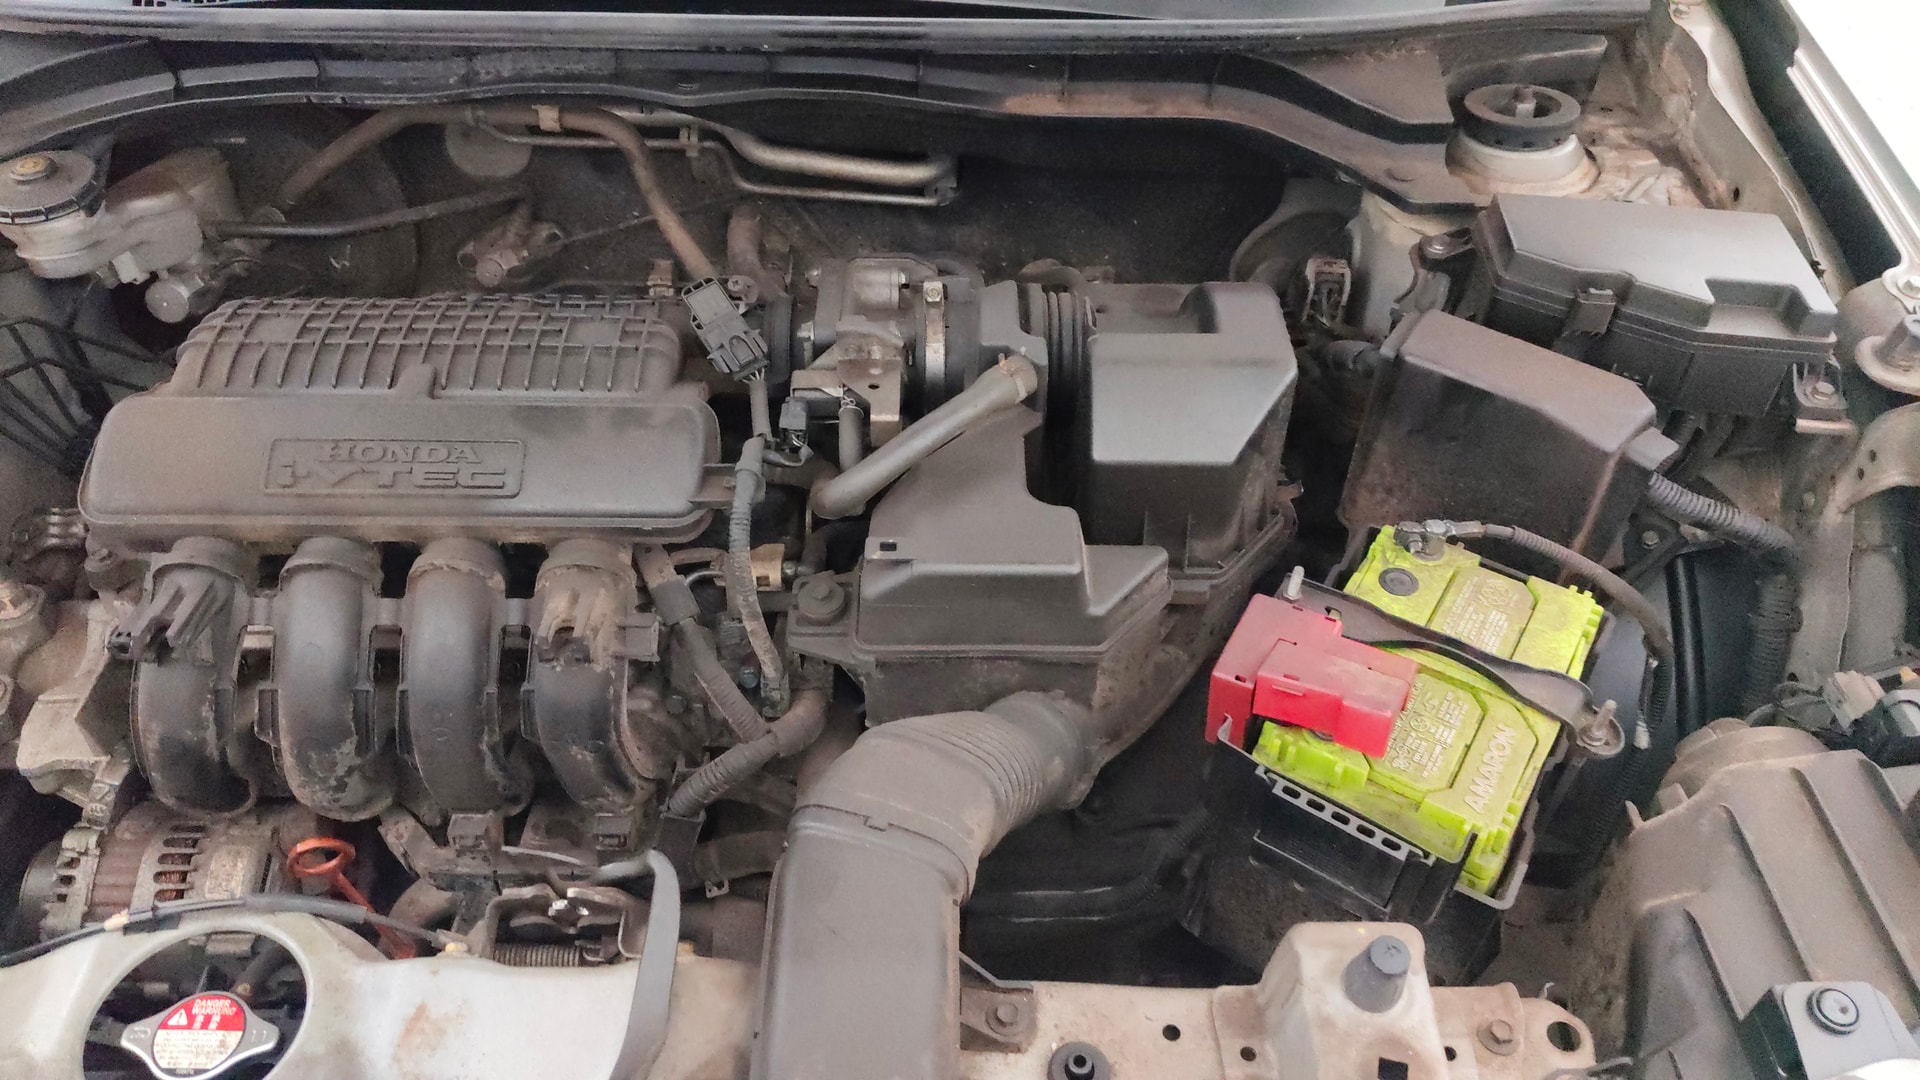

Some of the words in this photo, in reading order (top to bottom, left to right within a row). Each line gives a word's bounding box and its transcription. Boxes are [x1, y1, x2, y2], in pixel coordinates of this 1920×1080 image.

[320, 444, 483, 464] HONDA
[1464, 723, 1517, 814] AMARON
[194, 999, 232, 1008] DANGER
[192, 1007, 237, 1015] WARNING
